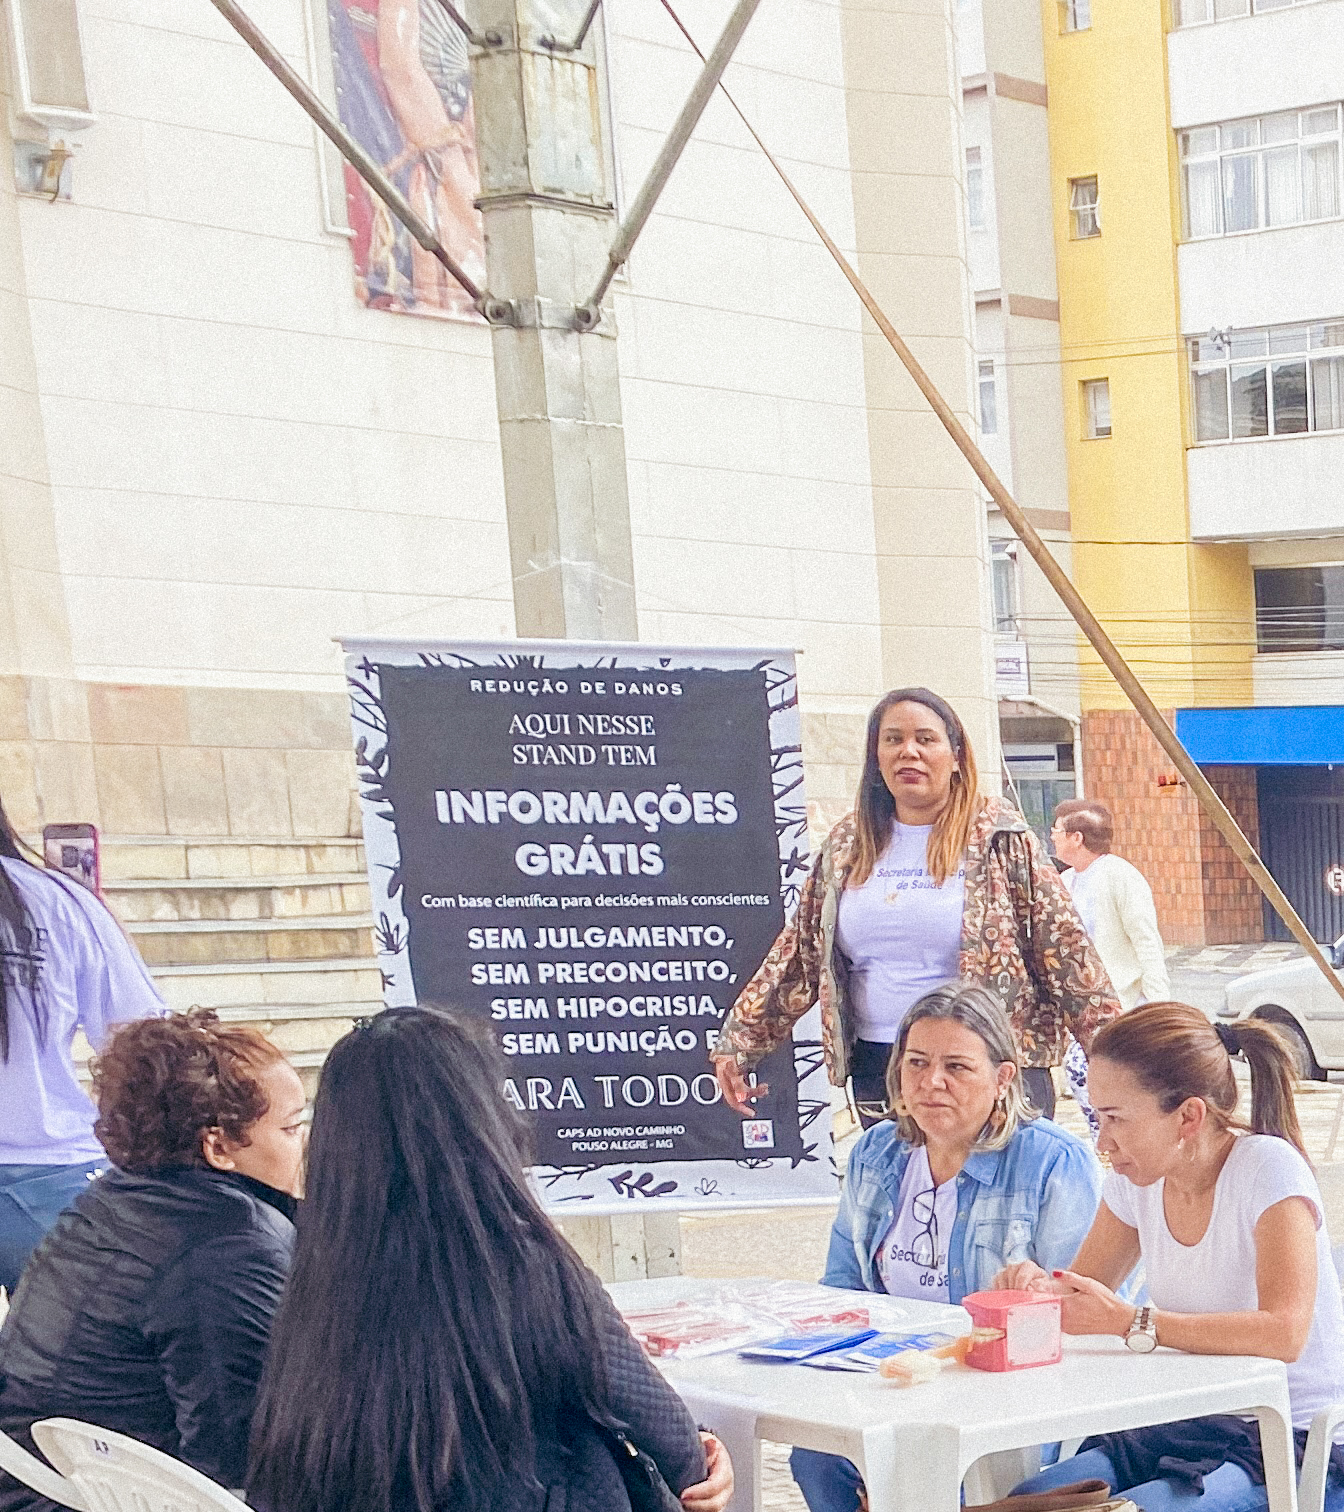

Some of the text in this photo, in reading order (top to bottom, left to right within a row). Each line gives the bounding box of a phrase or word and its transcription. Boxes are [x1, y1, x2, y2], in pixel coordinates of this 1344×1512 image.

[470, 678, 684, 697] REDUÇÃO DE DANOS
[508, 713, 656, 738] AQUI NESSE
[512, 744, 657, 766] STAND TEM
[434, 783, 738, 832] INFORMAÇÕES
[514, 834, 666, 877] GRÁTIS
[421, 892, 770, 911] Com base científica para decisões mais conscientes
[467, 925, 734, 950] SEM JULGAMENTO,
[471, 960, 738, 986] SEM PRECONCEITO,
[490, 994, 726, 1020] SEM HIPOCRISIA,
[502, 1032, 560, 1056] SEM
[567, 1024, 698, 1057] PUNIÇÃO
[502, 1071, 758, 1111] ARA TODO!
[557, 1124, 686, 1139] CAPS AD NOVO CAMINHO
[571, 1140, 609, 1152] POUSO
[609, 1139, 649, 1151] ALEGRE
[655, 1138, 674, 1149] MG
[919, 1272, 935, 1287] de
